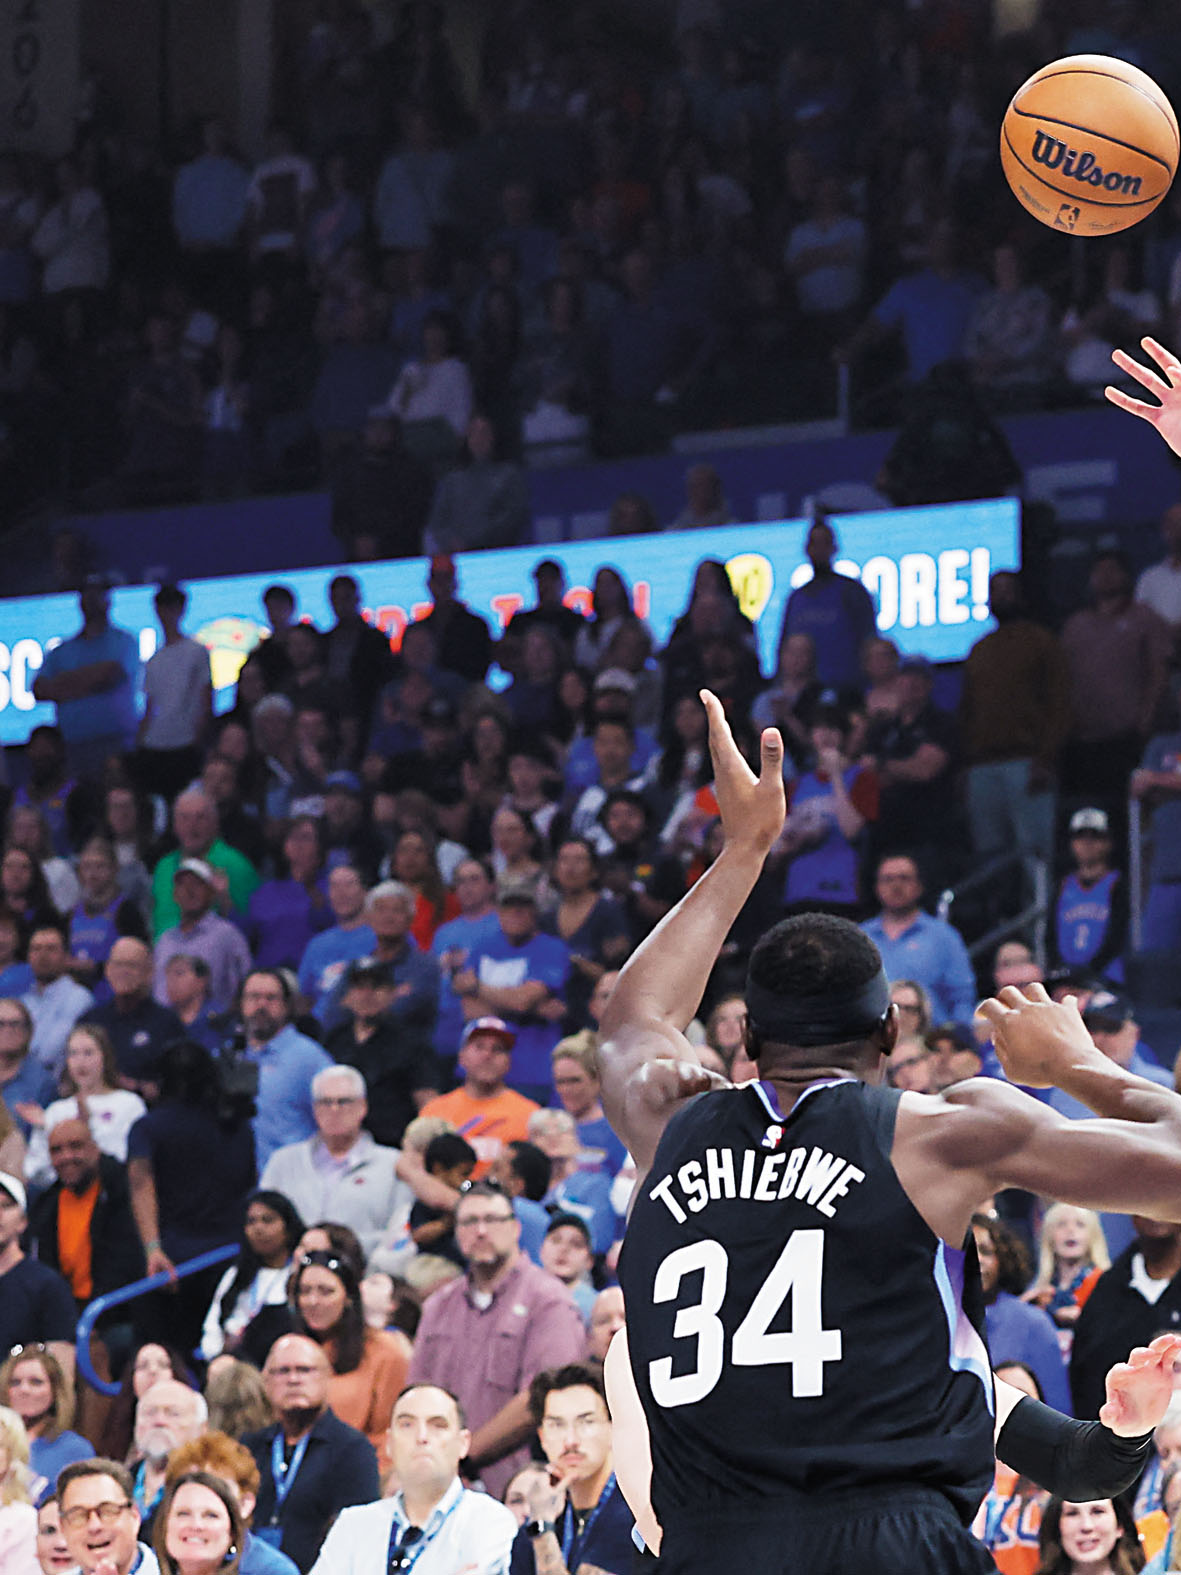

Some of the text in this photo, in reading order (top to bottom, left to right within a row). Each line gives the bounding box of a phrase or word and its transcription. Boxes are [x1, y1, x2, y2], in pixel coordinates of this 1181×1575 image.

[1031, 130, 1142, 196] Wilson
[790, 547, 991, 631] ORE!
[649, 1146, 866, 1224] TSHIEBWE
[649, 1229, 842, 1408] 34
